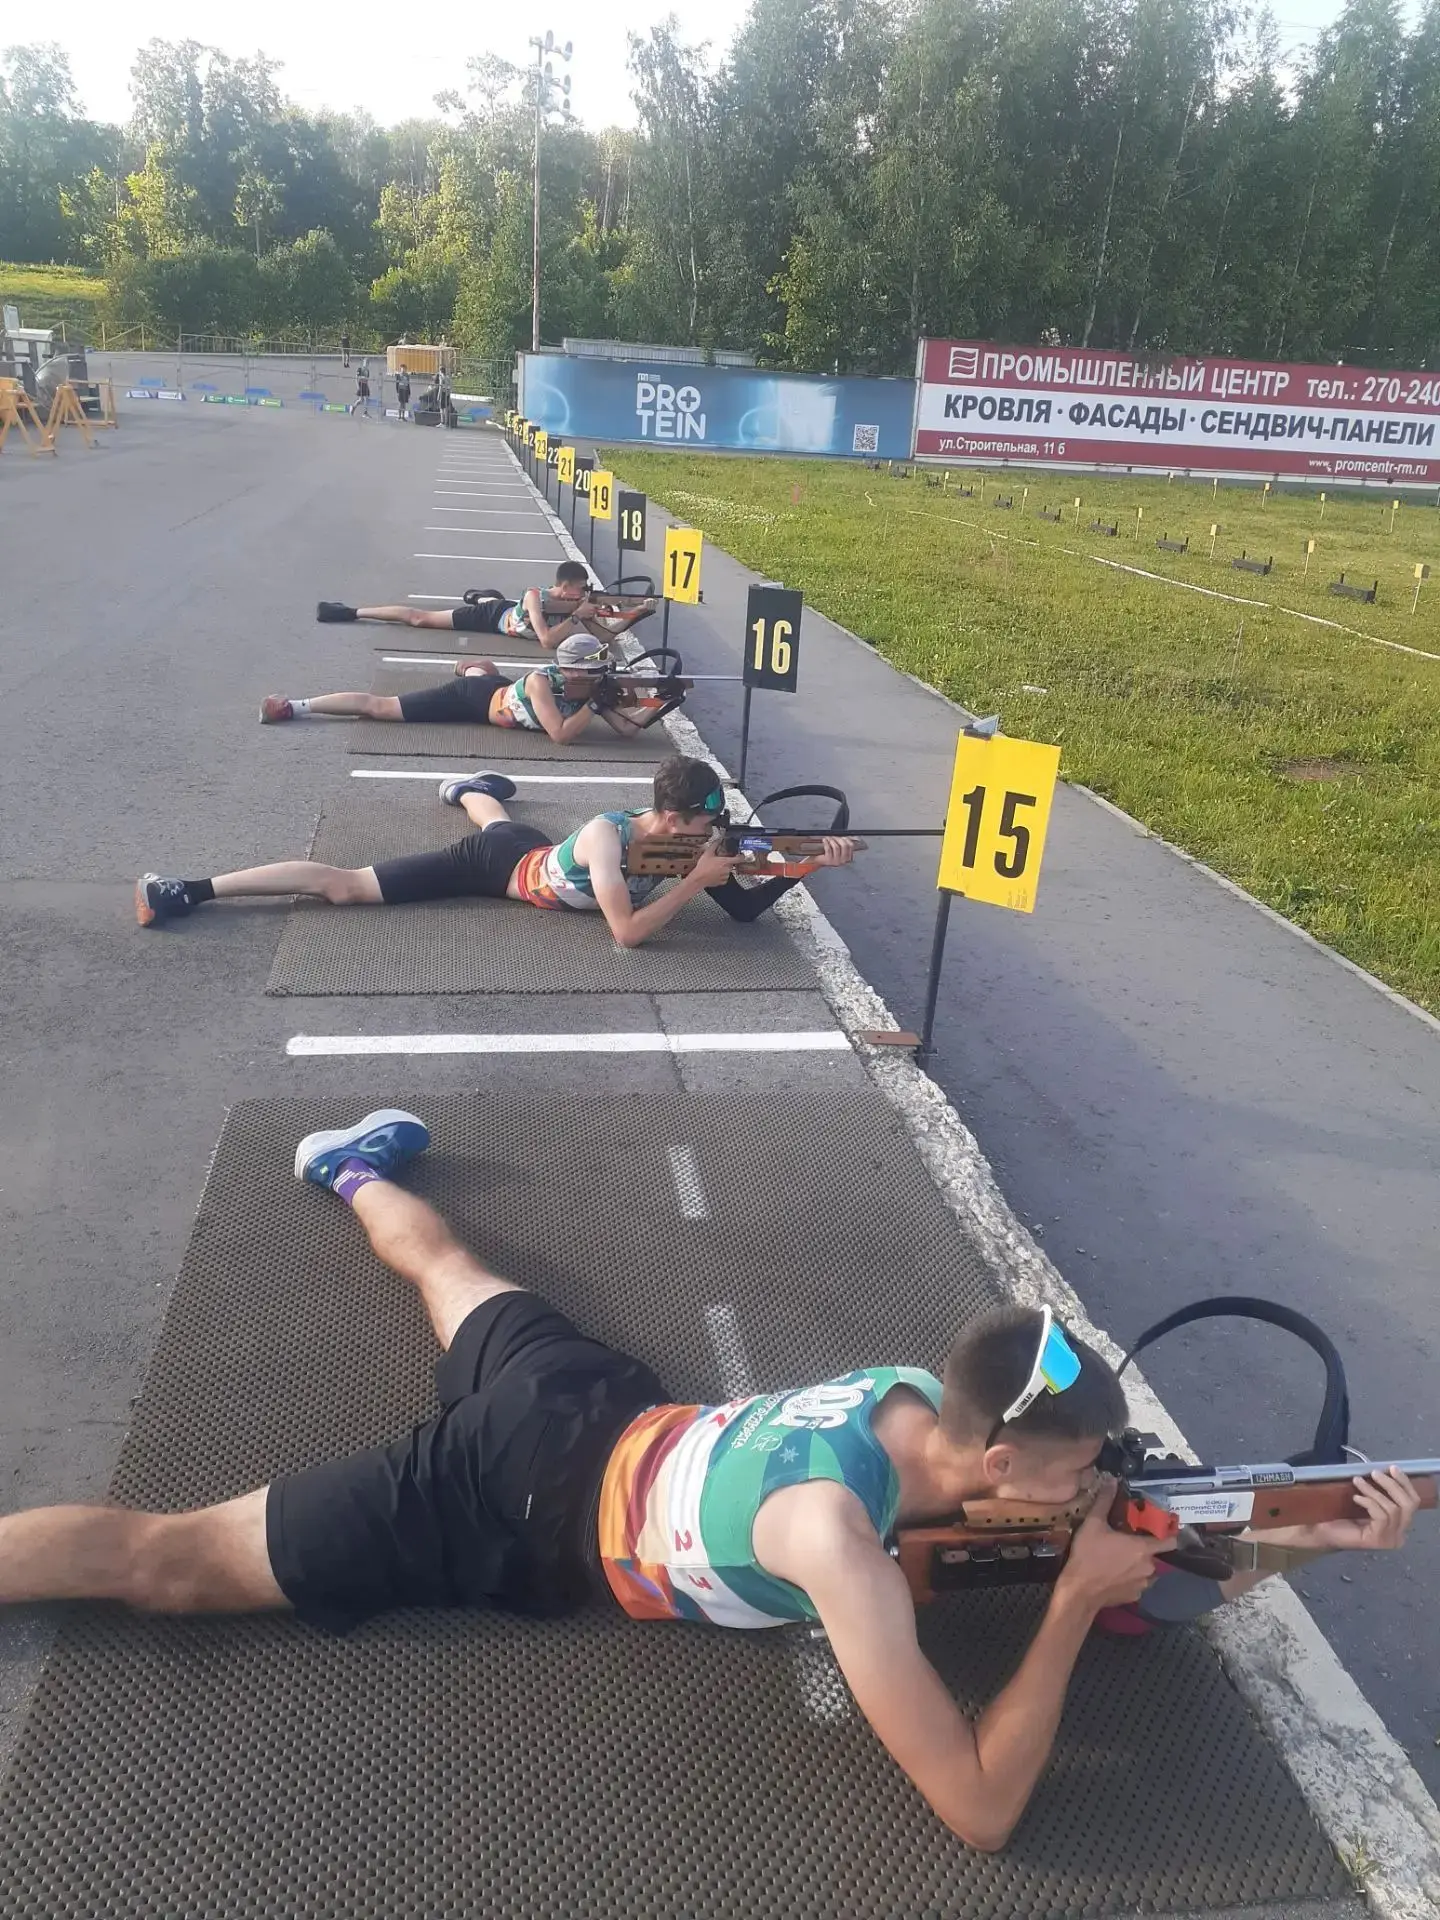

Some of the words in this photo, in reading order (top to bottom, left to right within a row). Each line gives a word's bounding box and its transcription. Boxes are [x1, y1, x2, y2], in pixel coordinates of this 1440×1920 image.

[982, 353, 1205, 392] ПРОМЫШЛЕННЫЙ
[1210, 367, 1290, 398] ЦЕНТР
[1307, 378, 1358, 400] тел.:
[1361, 376, 1440, 405] 270-240
[636, 382, 701, 413] PRO
[636, 409, 706, 440] TEIN
[943, 393, 1052, 424] КРОВЛЯ
[1068, 402, 1187, 435] ФАСАДЫ
[1200, 409, 1436, 447] СЕНДВИЧ-ПАНЕЛИ
[536, 439, 547, 455] 23
[1043, 442, 1056, 455] 11
[560, 457, 572, 476] 21
[575, 469, 591, 492] 20
[1334, 458, 1428, 476] promcentr-rm.ru
[592, 485, 609, 511] 19
[621, 509, 643, 541] 18
[669, 550, 697, 589] 17
[752, 617, 794, 675] 16
[962, 784, 1037, 879] 15
